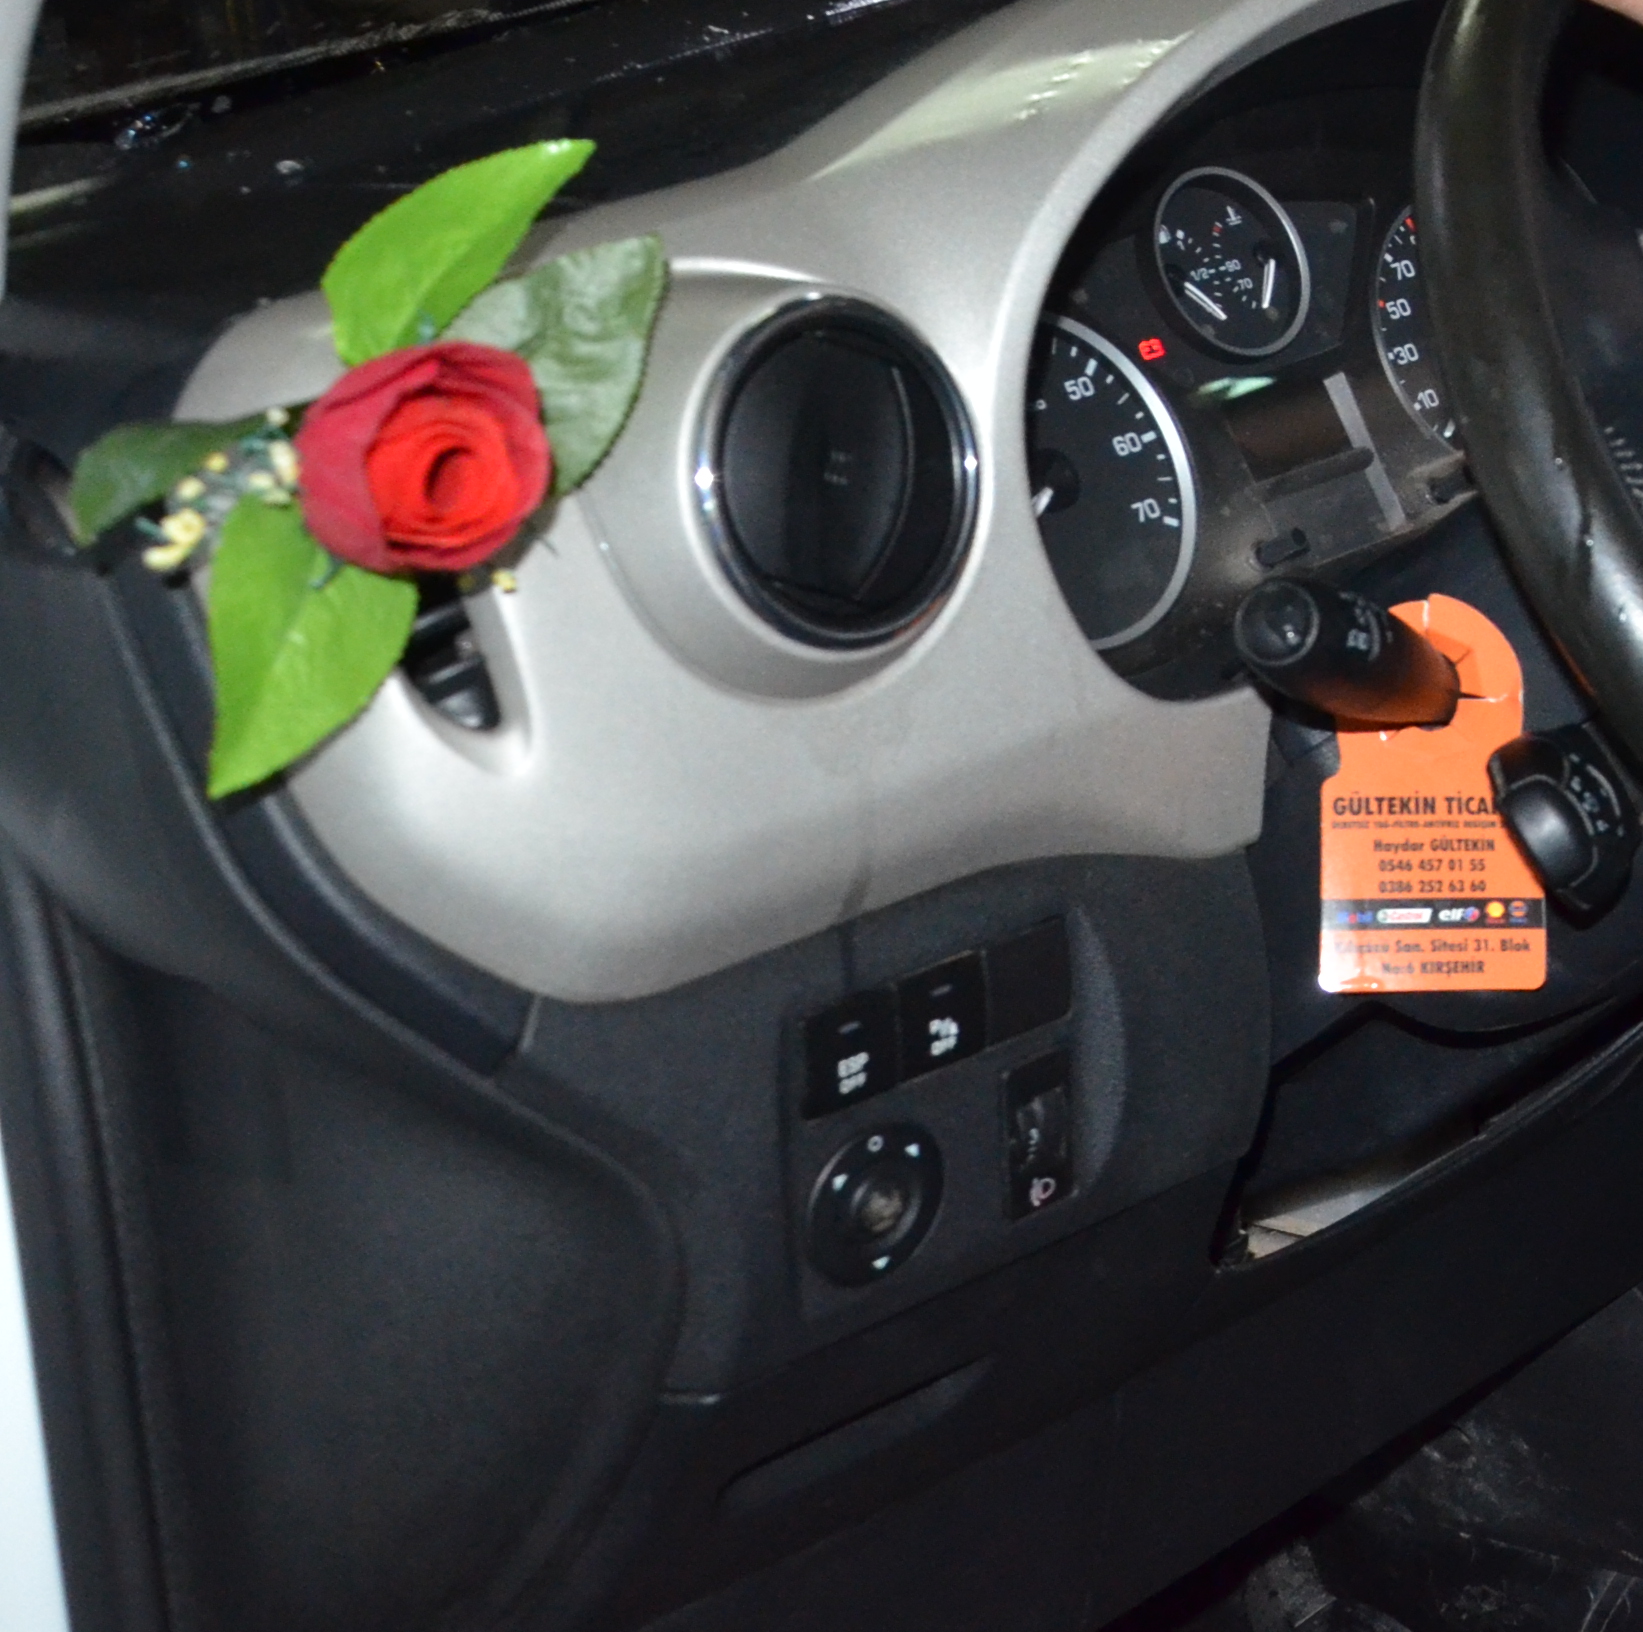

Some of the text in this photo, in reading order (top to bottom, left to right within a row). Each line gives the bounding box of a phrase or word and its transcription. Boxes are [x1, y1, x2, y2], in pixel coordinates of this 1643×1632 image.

[1390, 260, 1416, 280] 70
[1385, 298, 1411, 319] 50
[1393, 343, 1419, 365] 30
[1064, 376, 1095, 401] 50
[1417, 389, 1439, 409] 10
[1112, 432, 1142, 456] 60
[1131, 498, 1161, 523] 70
[1332, 791, 1436, 816] GÜLTEKİN
[1373, 835, 1496, 854] Haydar GÜLTEKİN
[1378, 859, 1486, 872] 0546 457 01 55
[1419, 879, 1443, 893] 252
[1449, 879, 1465, 893] 63
[1470, 879, 1487, 892] 60
[1438, 907, 1466, 922] elf
[1430, 939, 1469, 953] Sitesi
[1474, 939, 1495, 952] 31.
[1500, 939, 1531, 952] Blok
